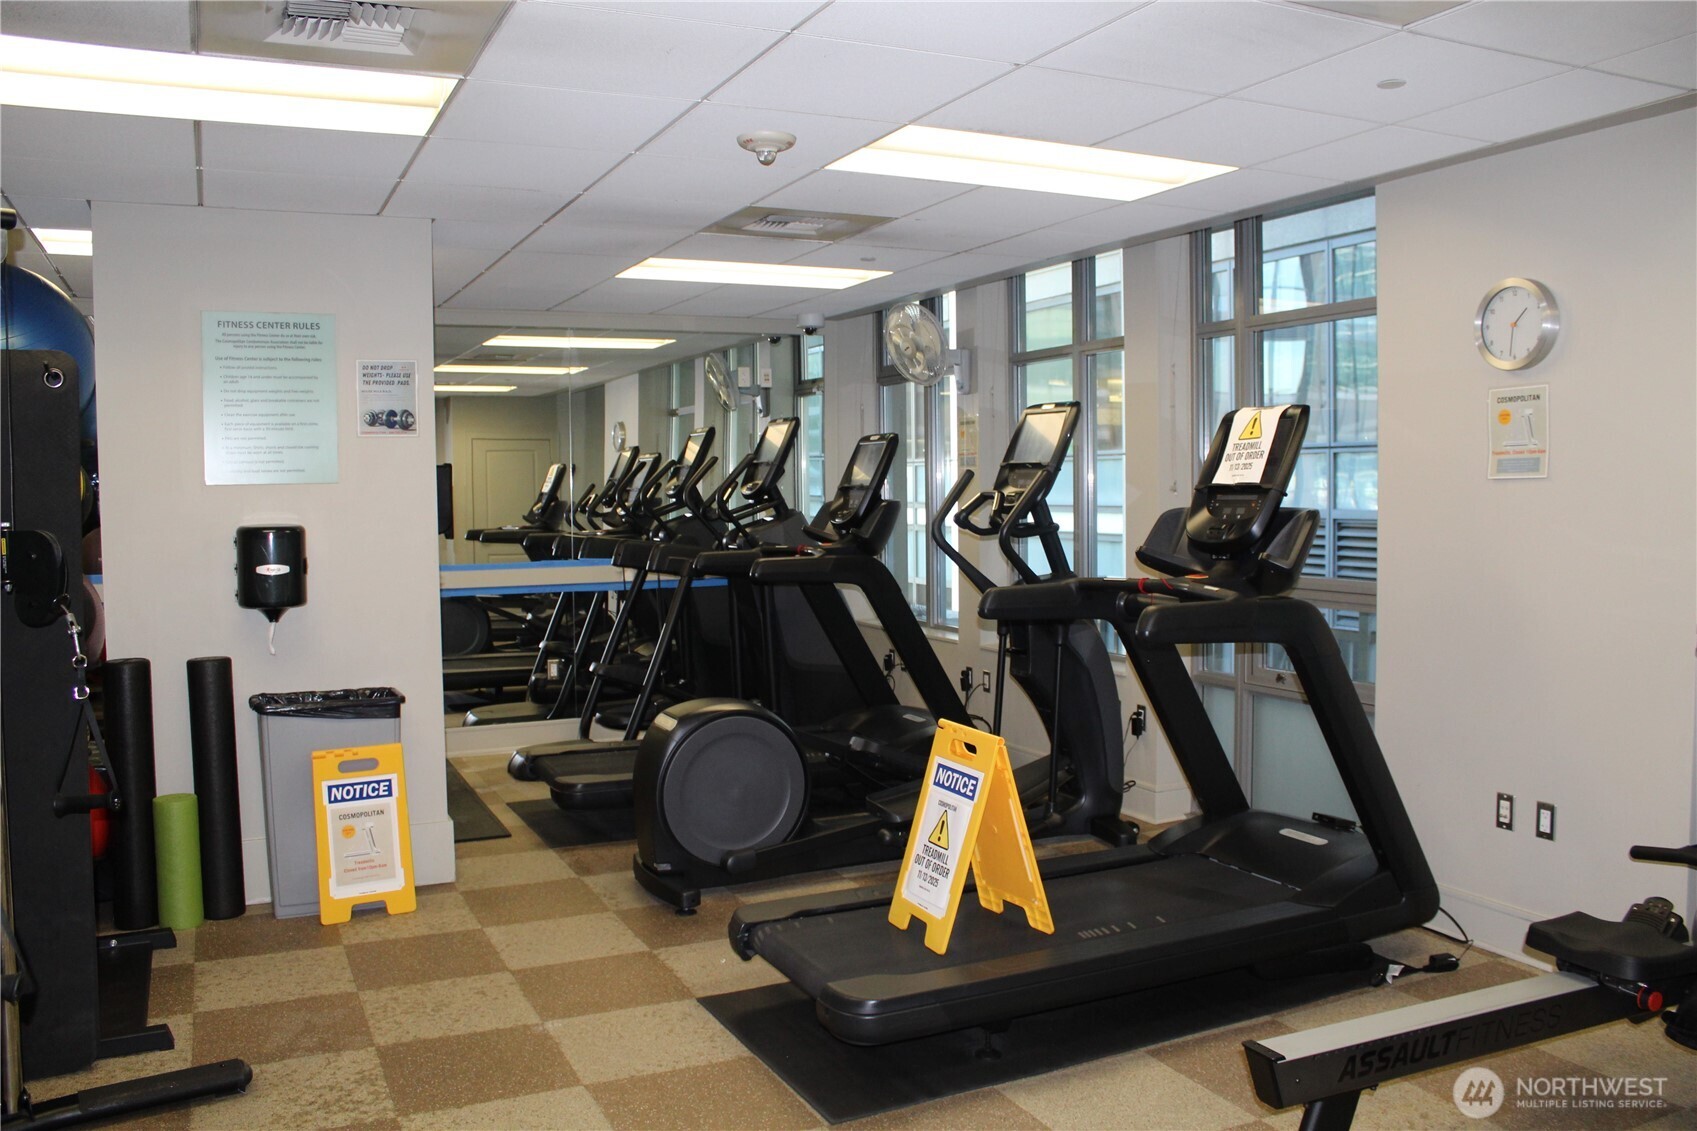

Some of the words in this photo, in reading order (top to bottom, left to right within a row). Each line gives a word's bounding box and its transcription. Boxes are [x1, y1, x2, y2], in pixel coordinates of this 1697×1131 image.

[217, 320, 254, 329] FITNESS
[256, 321, 291, 330] CENTER
[293, 322, 320, 330] RULES
[1497, 394, 1540, 403] COSMOPOLITAN
[1232, 441, 1262, 451] TREADMILL
[1225, 453, 1236, 462] OUT
[1236, 452, 1245, 461] OF
[1245, 450, 1265, 460] ORDER
[935, 767, 977, 797] NOTICE
[330, 781, 390, 801] NOTICE
[339, 809, 385, 820] COSMOPOLITAN
[922, 844, 949, 866] TREADMILL
[914, 854, 926, 867] OUT
[925, 858, 932, 871] OF
[932, 861, 950, 879] ORDER
